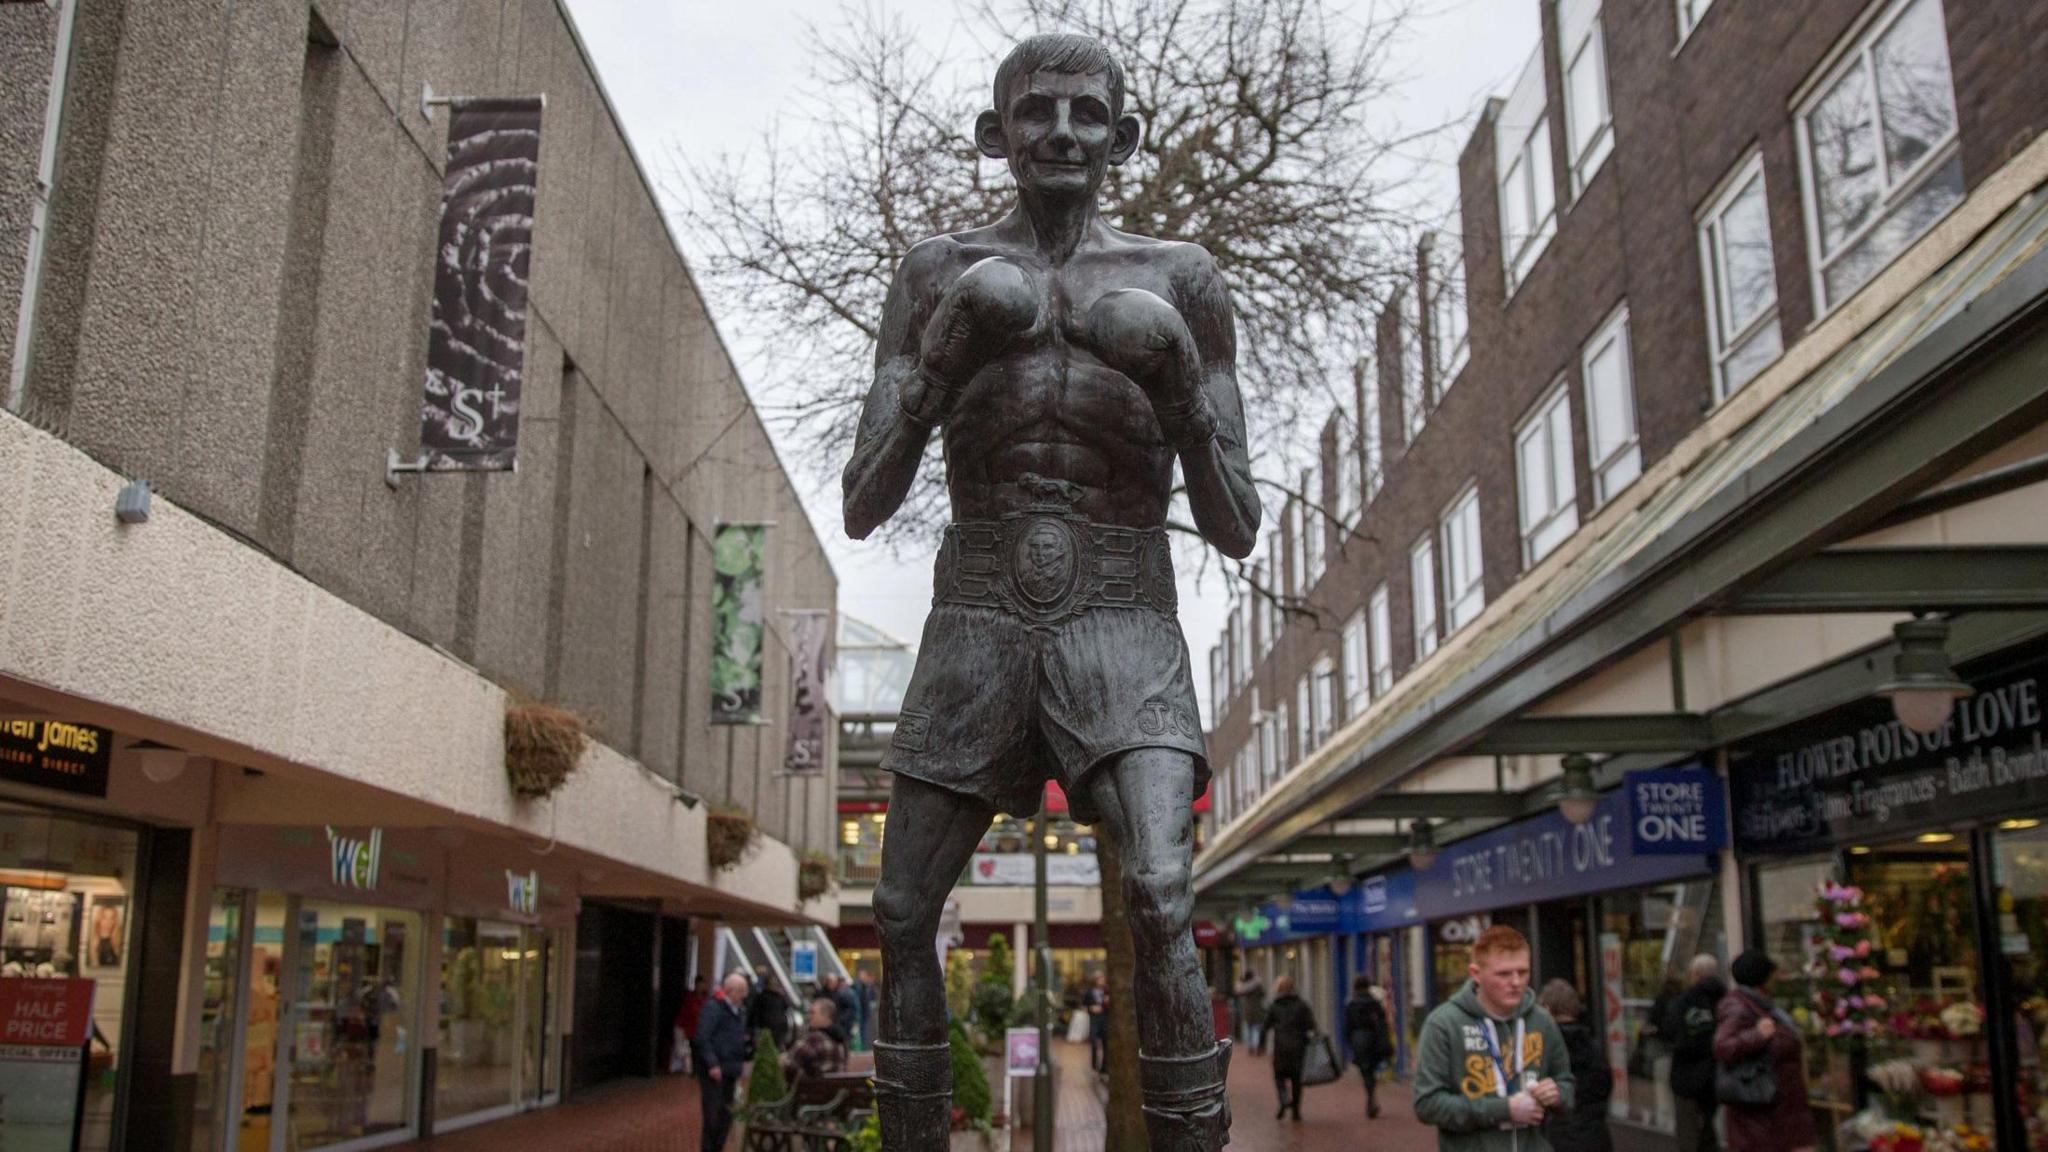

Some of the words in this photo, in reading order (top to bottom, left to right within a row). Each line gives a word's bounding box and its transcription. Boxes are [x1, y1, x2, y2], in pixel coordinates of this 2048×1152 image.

[1777, 735, 1858, 788] FLOWER
[1859, 719, 1920, 768] POTS
[1960, 678, 2041, 743] LOVE
[1636, 782, 1704, 801] STORE
[1852, 780, 1936, 823] Fragrances
[1947, 748, 1991, 794] Bath
[1639, 800, 1703, 815] TWENTY
[1637, 815, 1707, 842] ONE
[1453, 850, 1493, 898] STORE
[1496, 830, 1567, 883] TWENTY
[1572, 815, 1614, 871] ONE
[14, 1000, 68, 1019] HALF
[6, 1020, 69, 1040] PRICE
